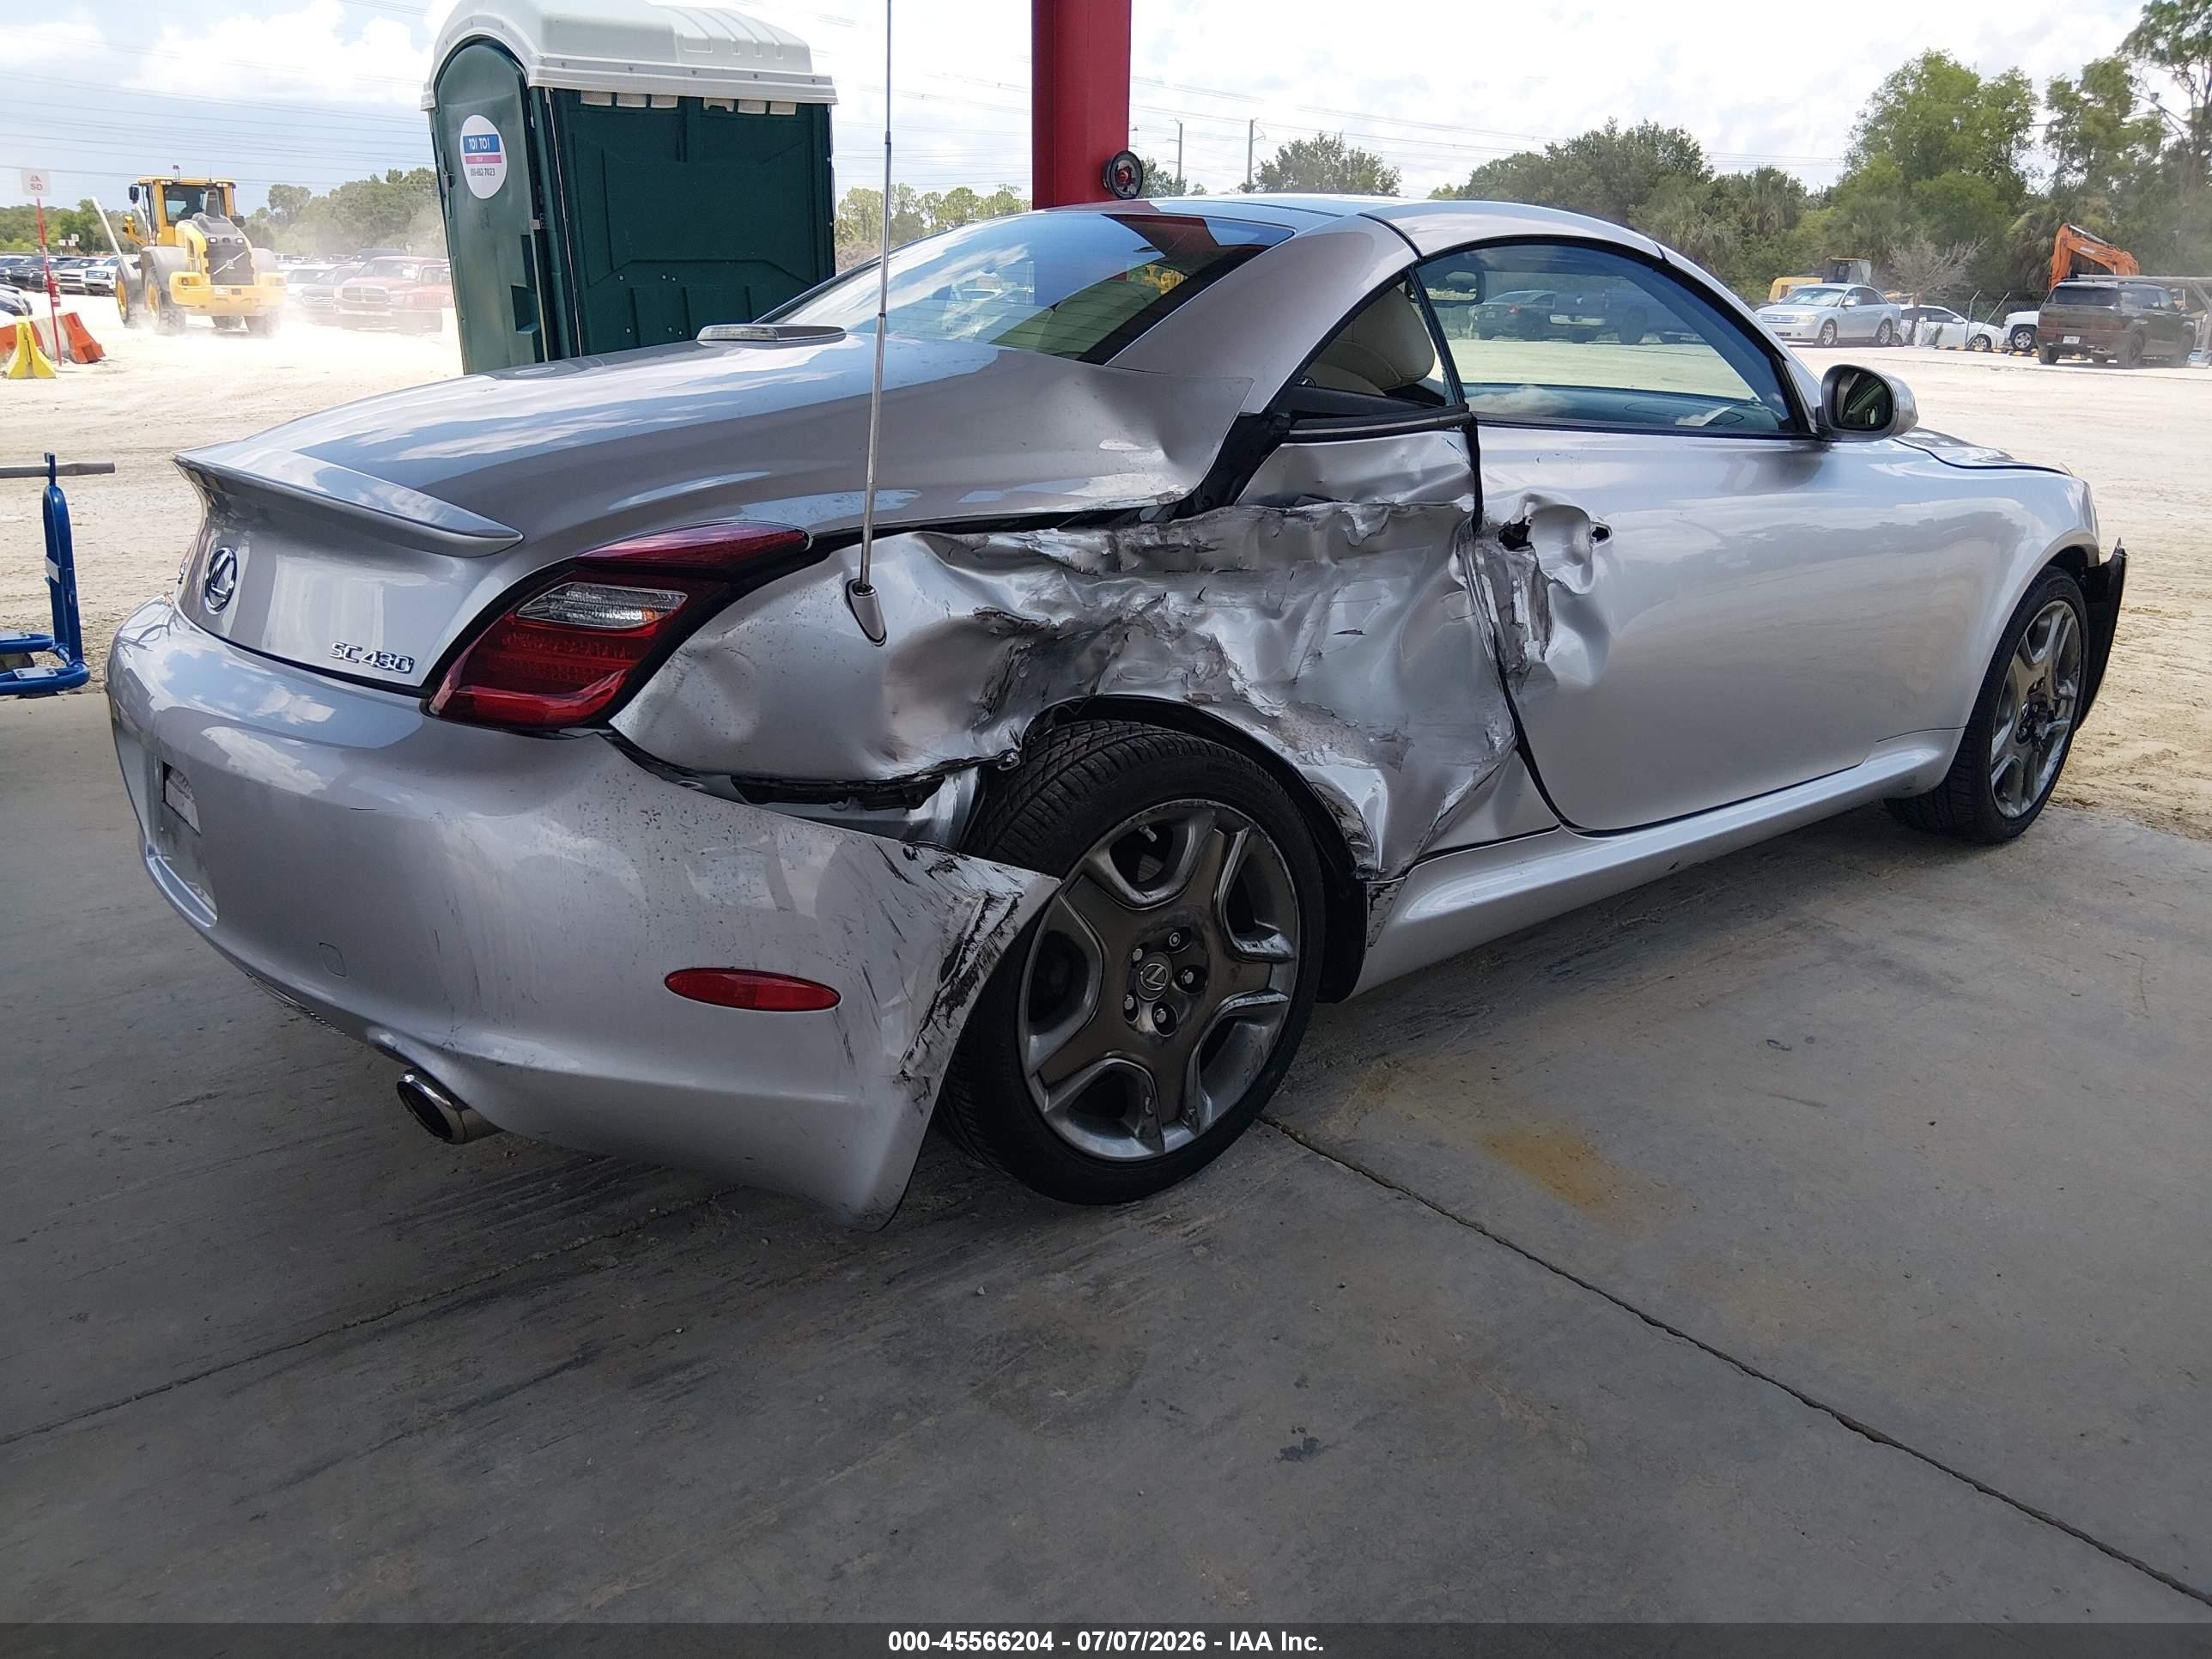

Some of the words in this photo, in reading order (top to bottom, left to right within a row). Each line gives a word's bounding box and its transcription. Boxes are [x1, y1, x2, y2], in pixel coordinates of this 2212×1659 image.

[479, 137, 490, 149] TOI
[329, 641, 362, 664] SC
[361, 650, 416, 675] 430
